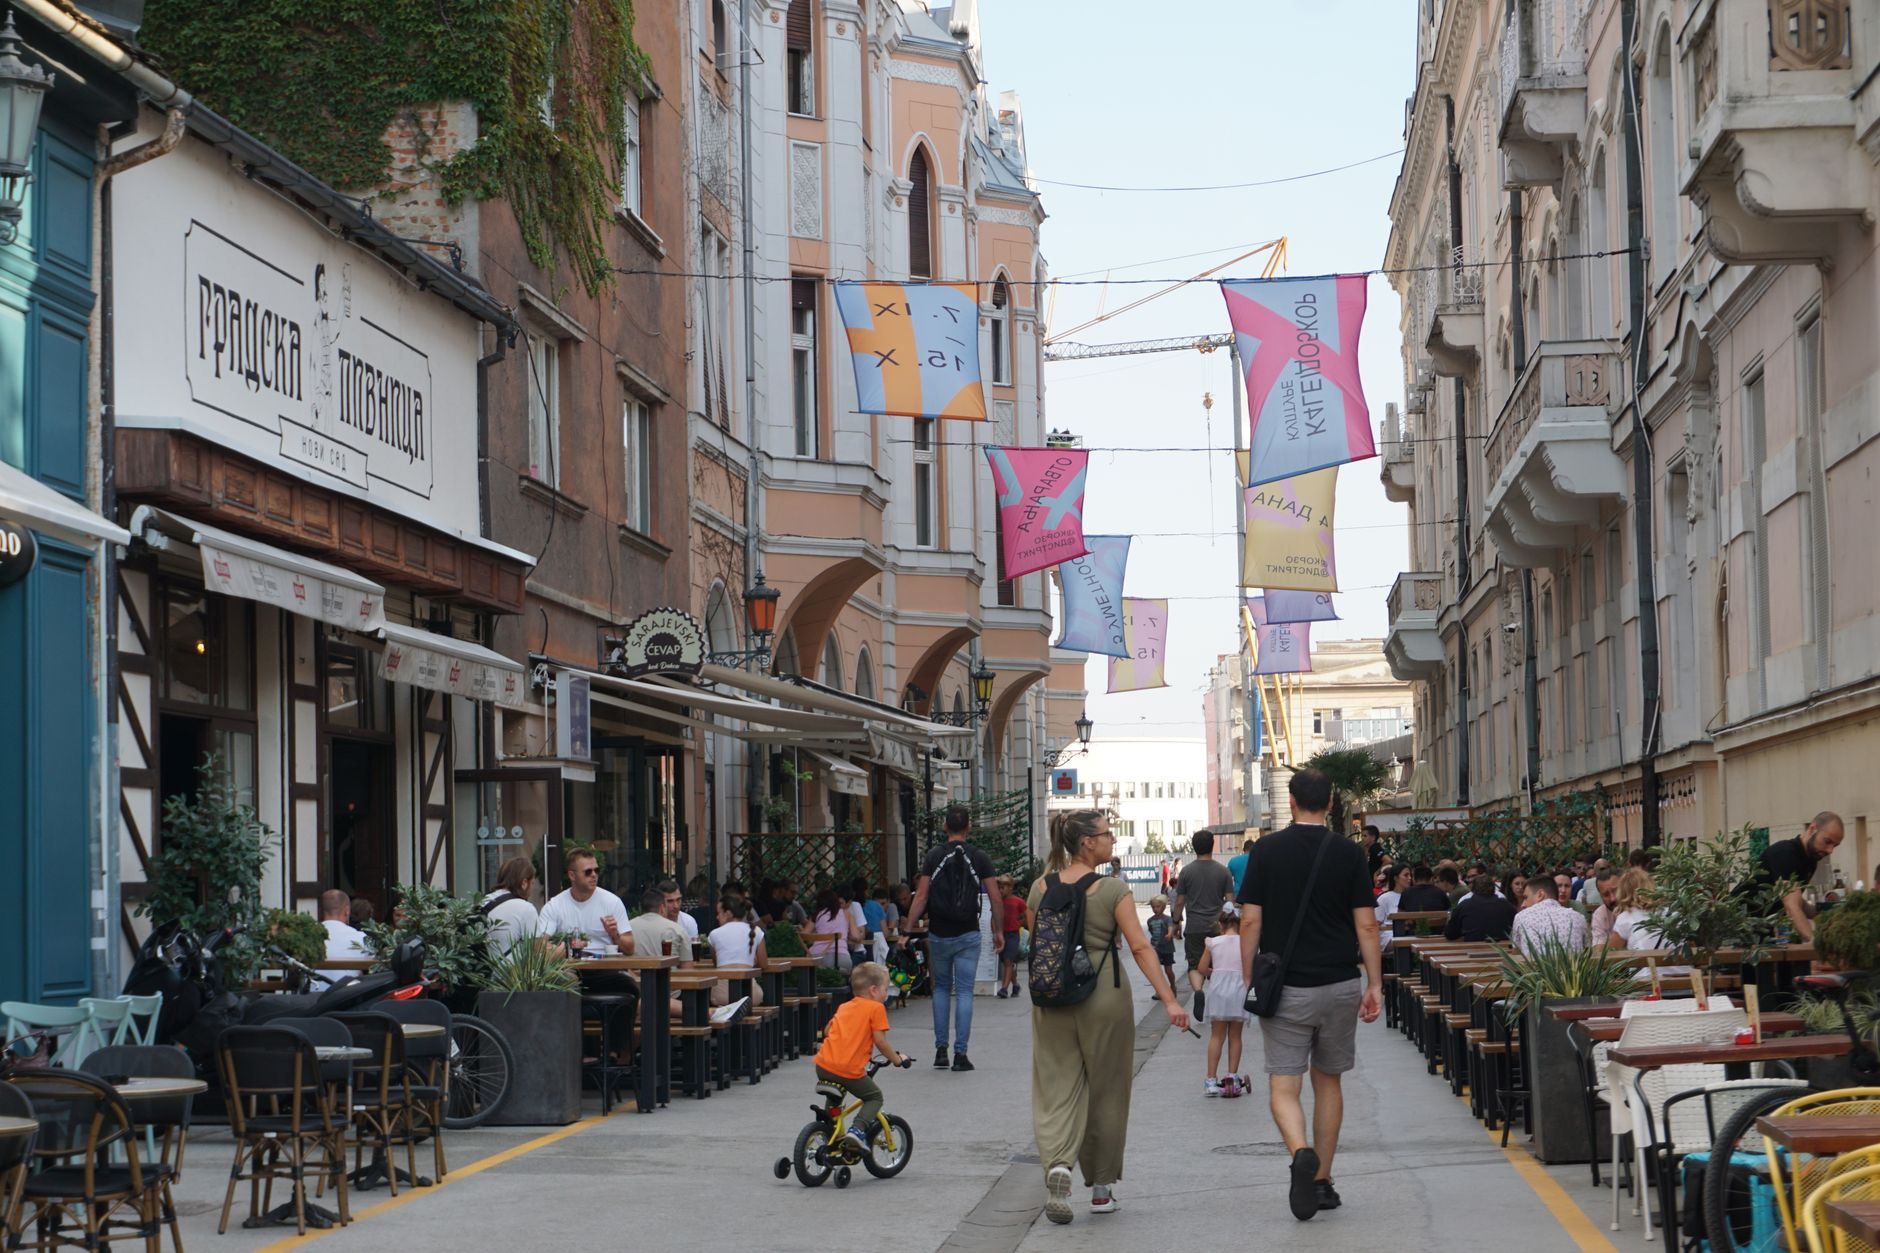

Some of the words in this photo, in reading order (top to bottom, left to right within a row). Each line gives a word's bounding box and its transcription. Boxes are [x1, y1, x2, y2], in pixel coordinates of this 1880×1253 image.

[198, 274, 303, 401] ГРАДСКА
[338, 349, 425, 463] ПИВНИЦА
[631, 618, 695, 648] SARAJEVSKI
[646, 643, 681, 656] ĆEVAP
